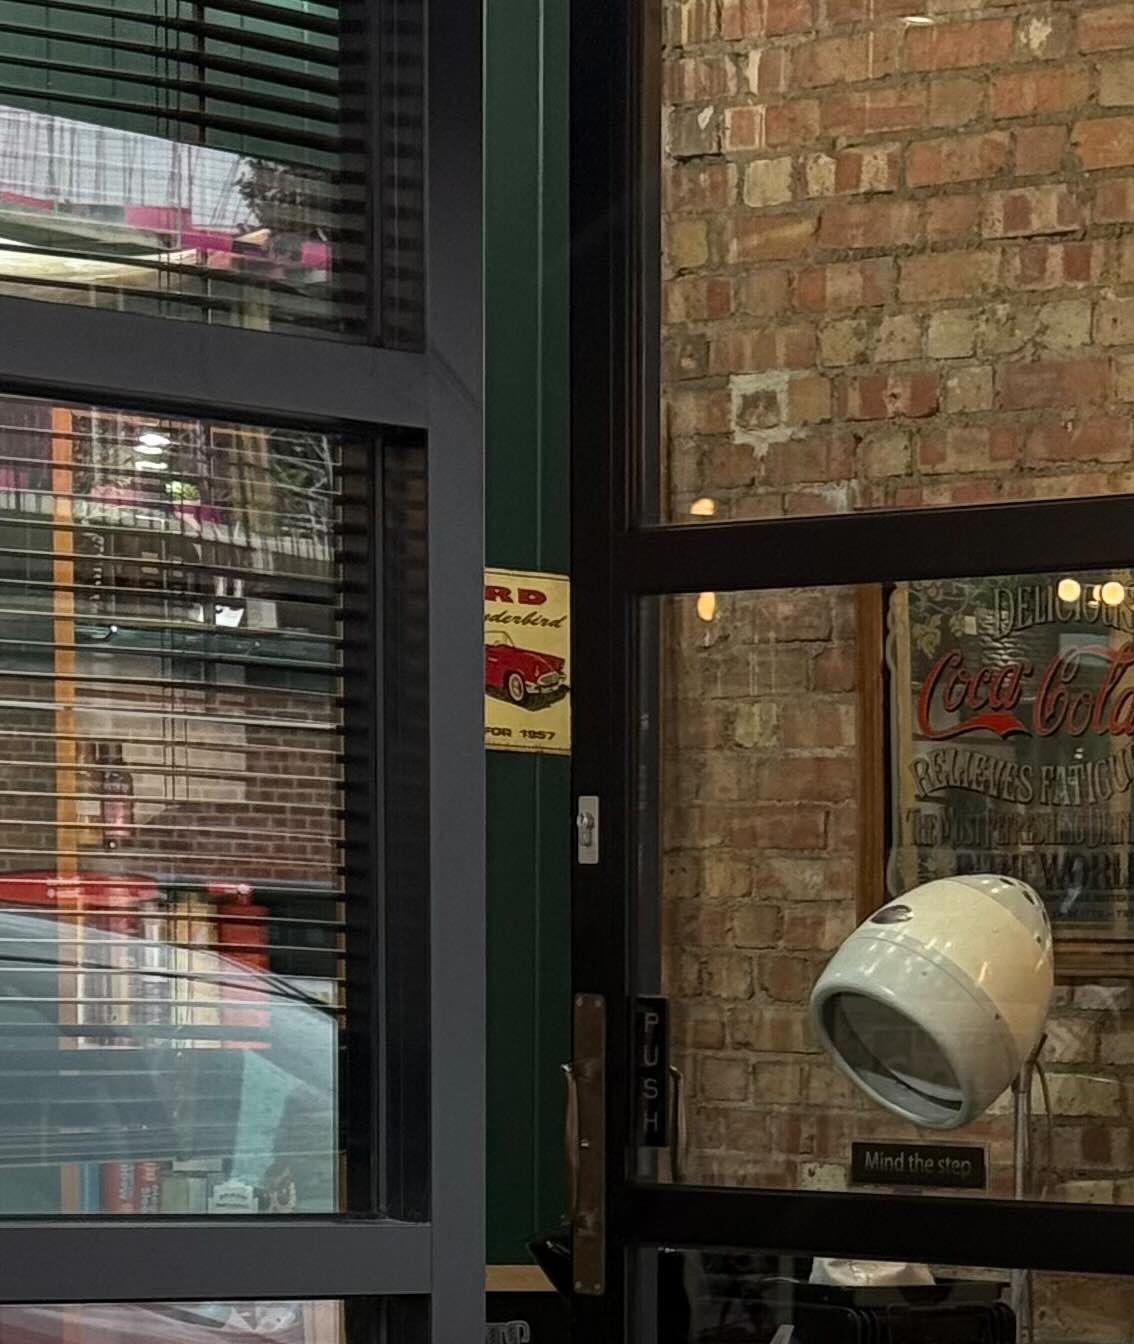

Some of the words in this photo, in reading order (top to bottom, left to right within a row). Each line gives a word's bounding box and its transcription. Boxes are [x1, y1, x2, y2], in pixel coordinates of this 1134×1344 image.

[520, 728, 556, 740] 1957
[909, 748, 1034, 804] RELIEVES
[643, 1012, 659, 1134] PUSH
[864, 1151, 904, 1170] Mind
[908, 1153, 934, 1172] the
[937, 1157, 971, 1179] step
